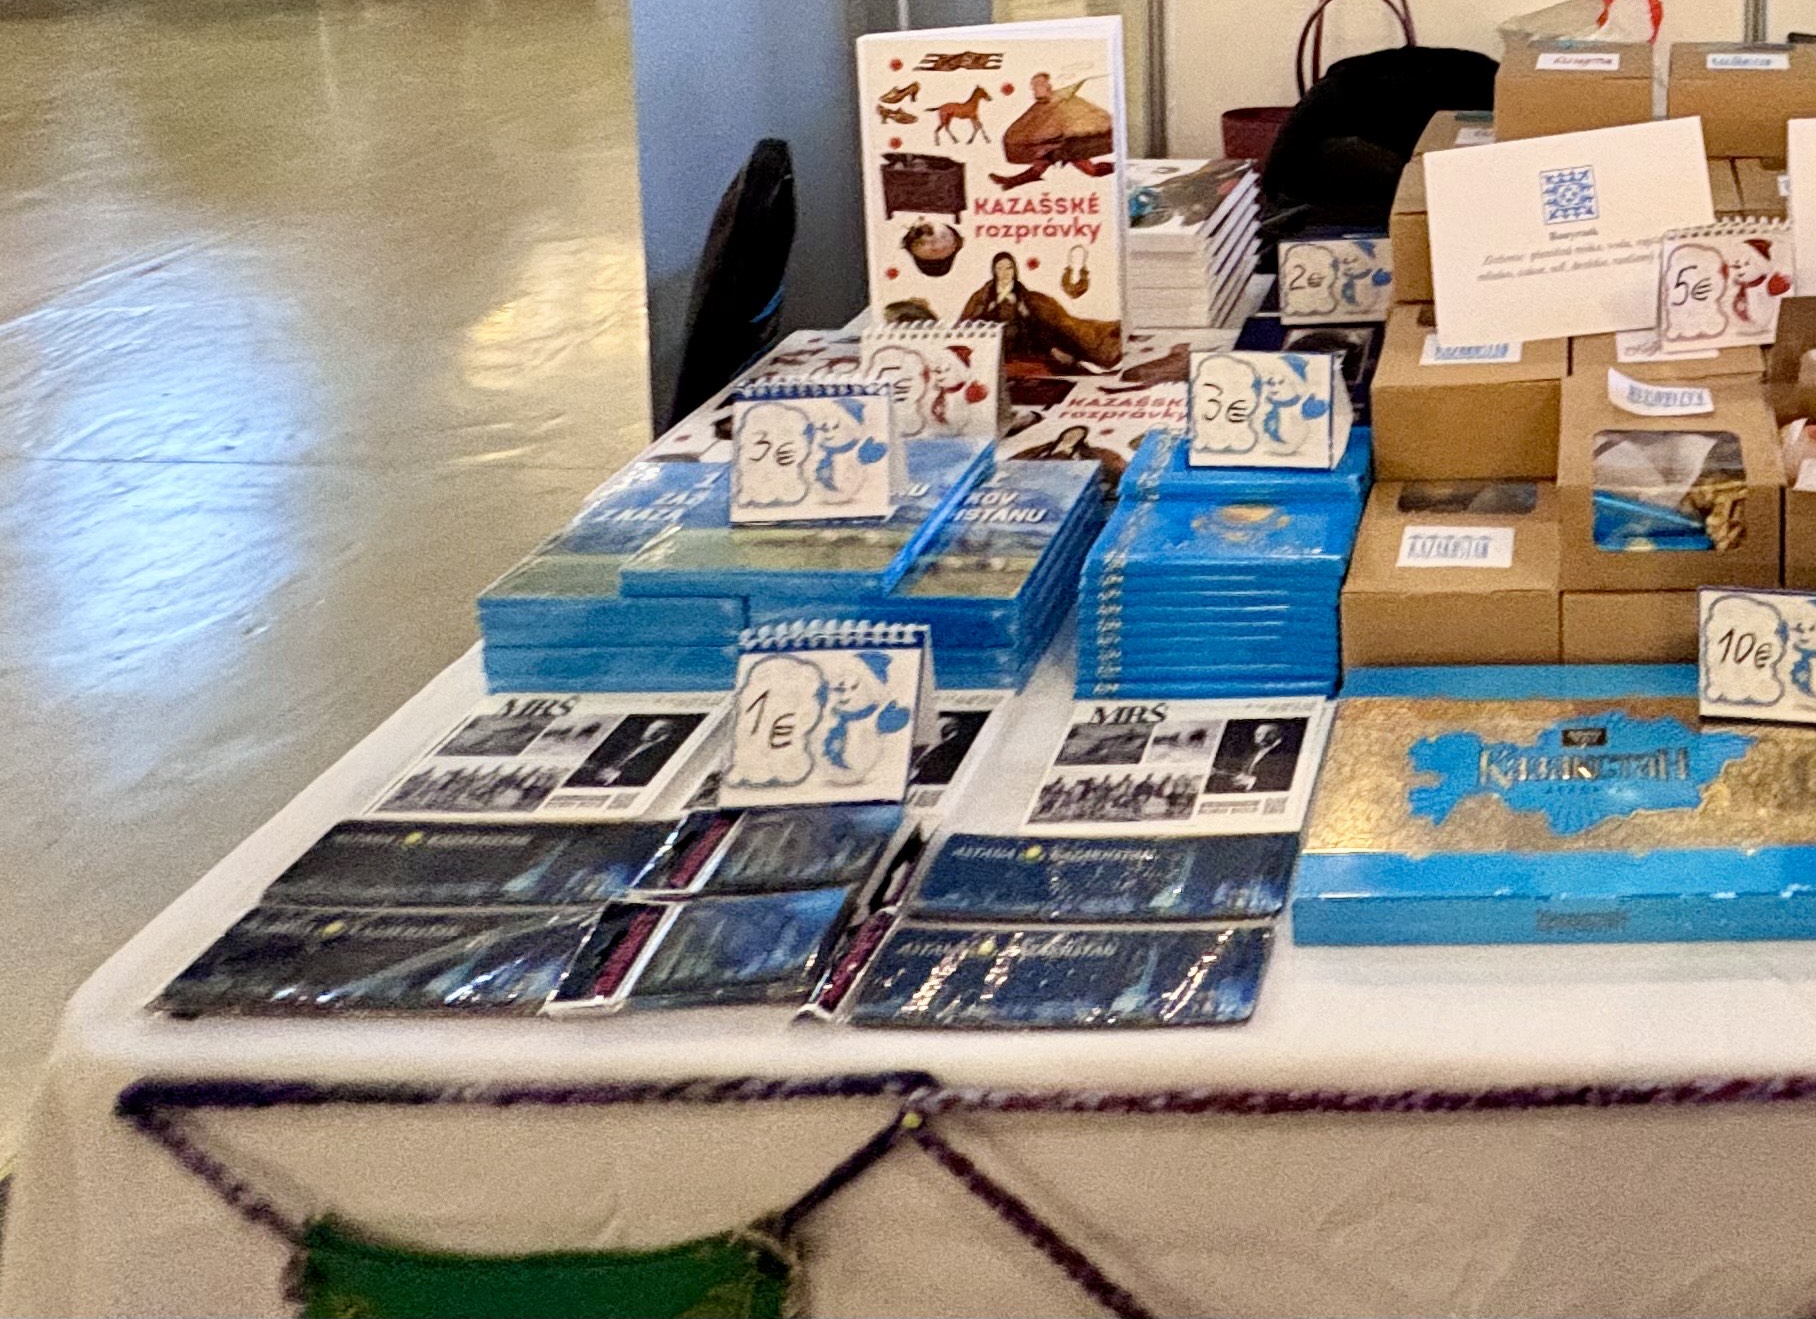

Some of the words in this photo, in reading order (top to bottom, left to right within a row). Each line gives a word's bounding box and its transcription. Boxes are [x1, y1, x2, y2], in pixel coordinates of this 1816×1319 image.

[974, 192, 1101, 215] KAZAŠSKÉ
[975, 216, 1102, 245] rozprávky
[1288, 263, 1325, 291] 2€
[1671, 264, 1713, 307] 5€
[1067, 395, 1185, 408] KAZAŠSK
[1202, 382, 1249, 424] 3€
[748, 430, 797, 467] 3€
[1717, 626, 1774, 670] 10€
[744, 687, 797, 750] 1€
